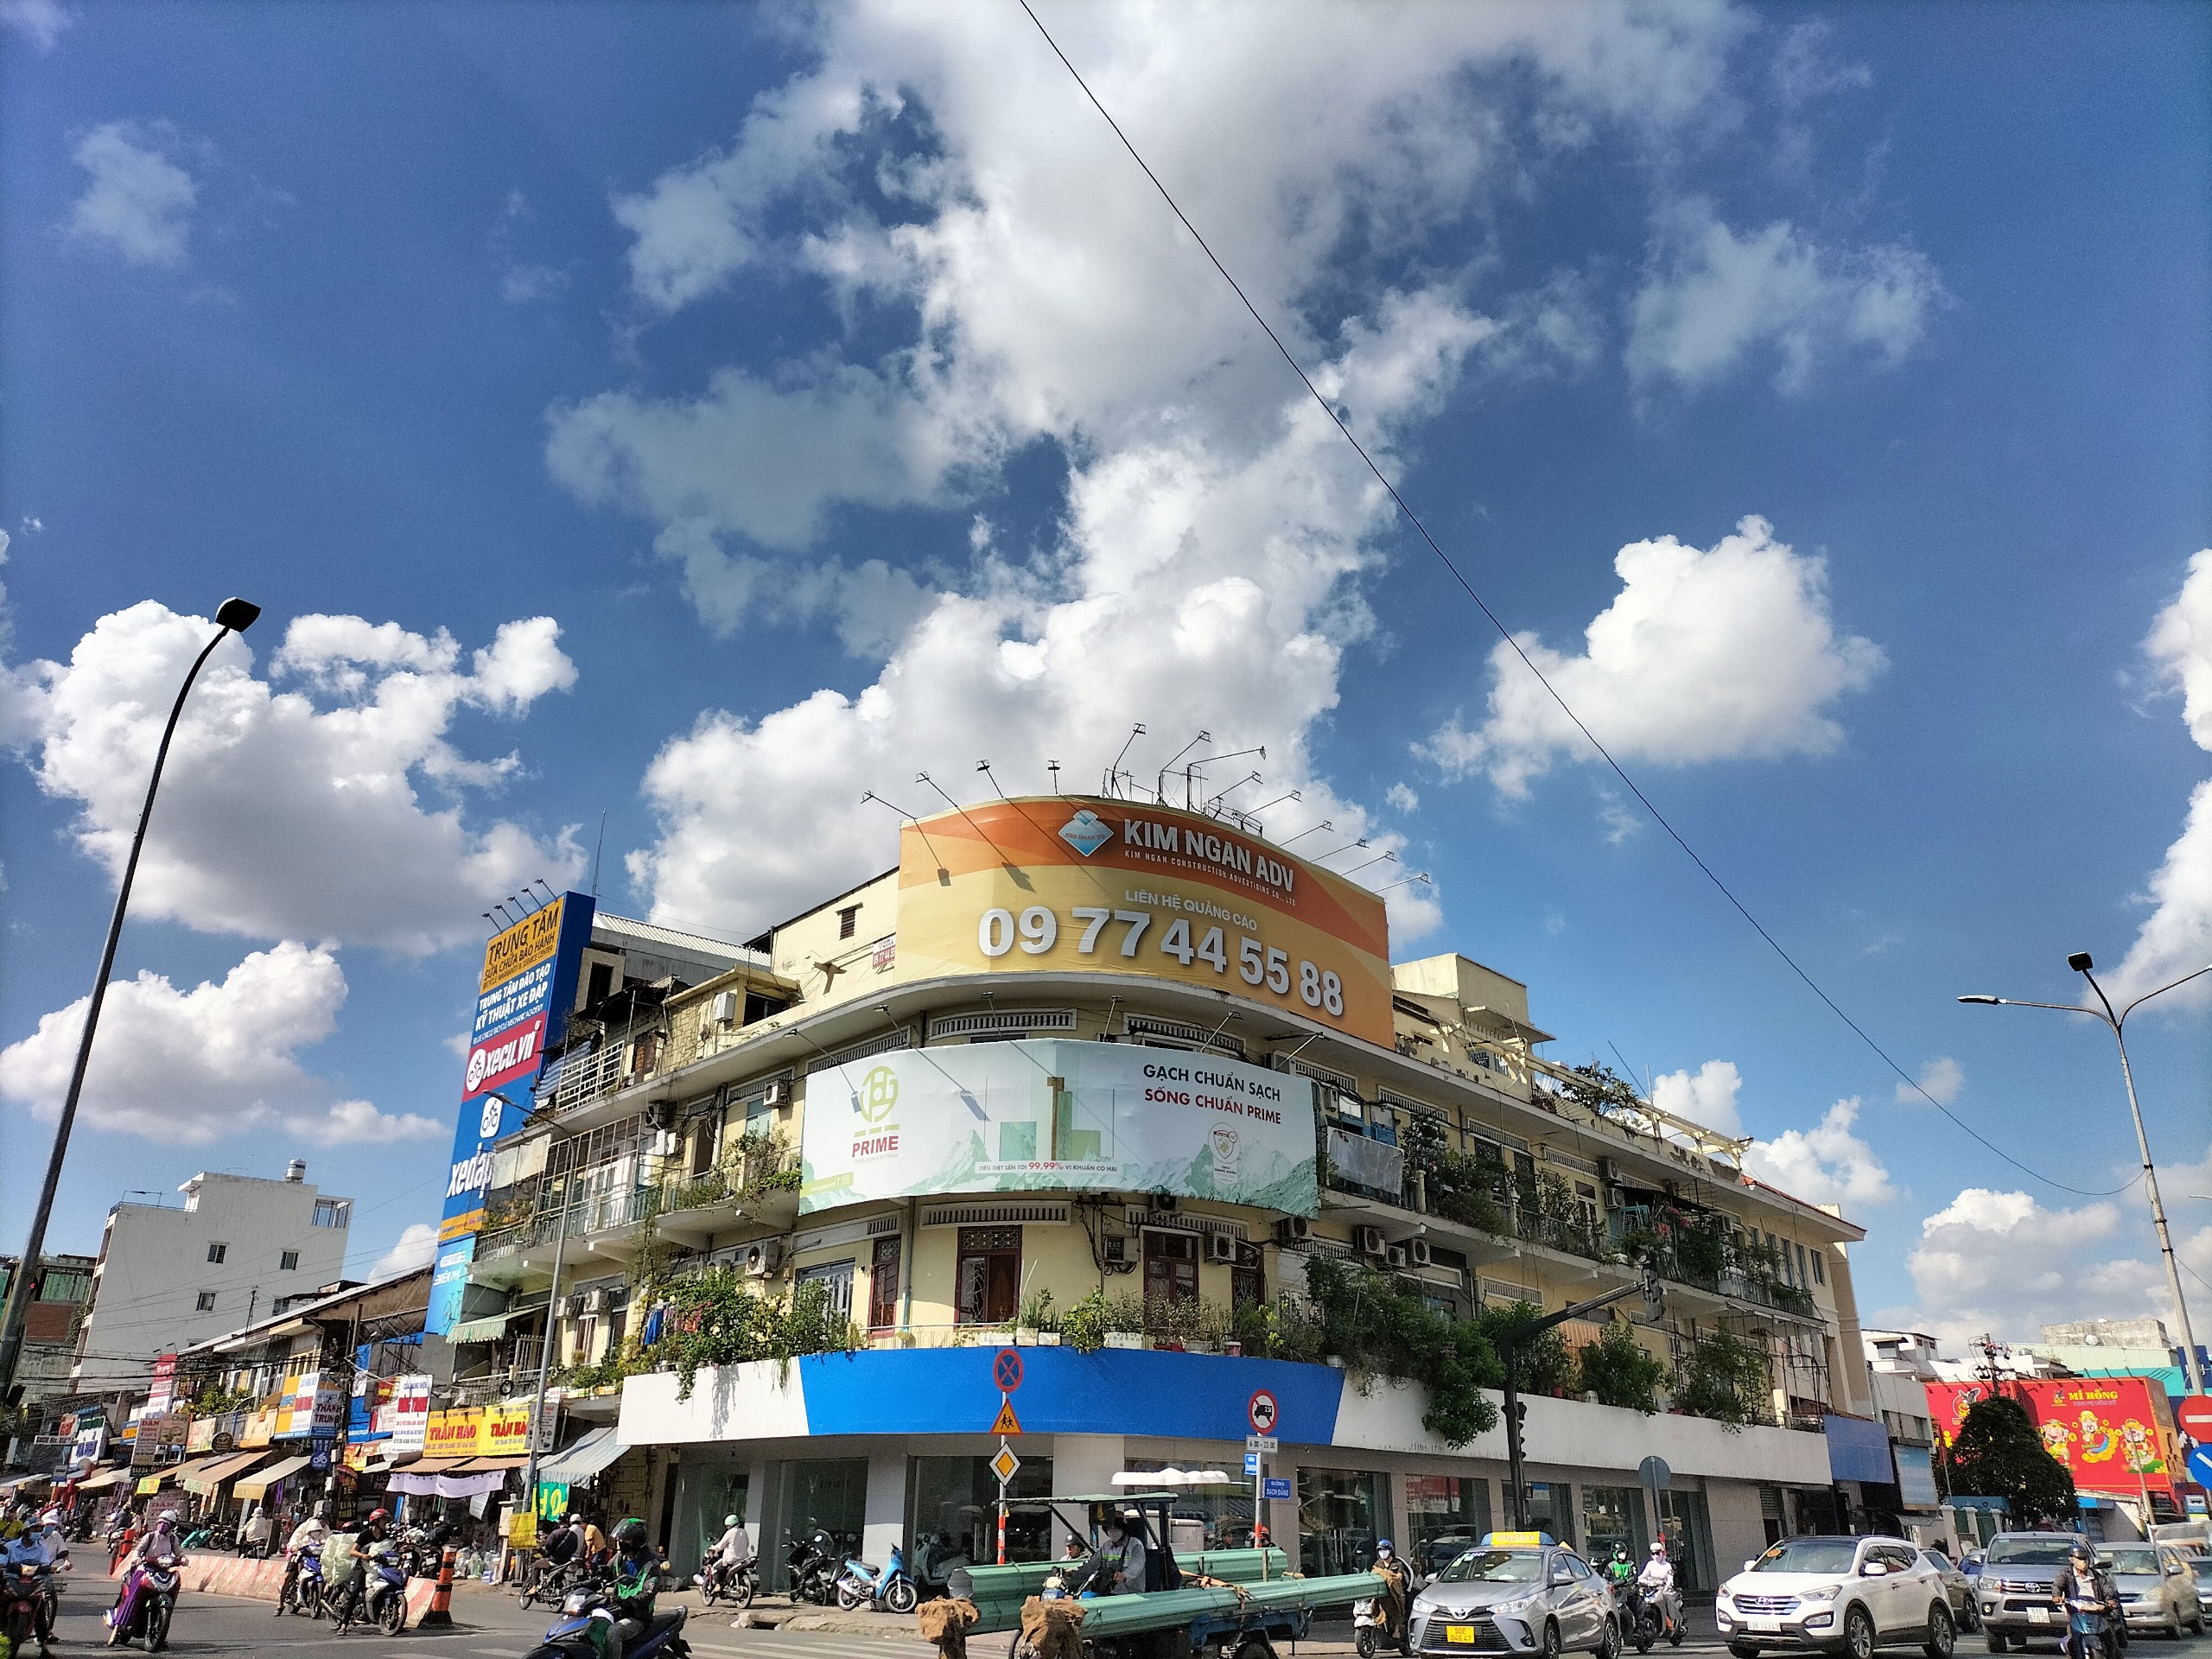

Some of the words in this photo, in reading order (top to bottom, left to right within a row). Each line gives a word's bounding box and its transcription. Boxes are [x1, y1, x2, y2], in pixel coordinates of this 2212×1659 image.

[1124, 818, 1178, 853] KIM
[1185, 830, 1251, 874] NGAN
[1256, 855, 1294, 893] ADV
[1124, 850, 1141, 860] KIM
[1145, 853, 1167, 863] NGAN
[1171, 857, 1227, 879] CONSTRUCTION
[1229, 873, 1269, 896] ADVERTISING
[1125, 889, 1159, 906] LIÊN
[1161, 893, 1181, 911] HỆ
[1183, 899, 1230, 922] QUẢNG
[1232, 911, 1257, 932] CÁO
[489, 925, 529, 965] TRUNG
[532, 906, 560, 939] TÂM
[977, 906, 1058, 957] 09
[1071, 906, 1151, 957] 77
[1160, 918, 1228, 975] 44
[1238, 935, 1290, 995] 55
[1299, 960, 1344, 1017] 88
[475, 1009, 488, 1032] KỸ
[488, 996, 516, 1026] THUẬT
[516, 990, 528, 1011] XE
[528, 981, 549, 1004] ĐẠP
[480, 987, 502, 1011] TRUNG
[503, 981, 518, 999] TÂM
[518, 971, 535, 991] ĐÀO
[535, 963, 550, 983] TẠO
[1143, 1064, 1189, 1082] GẠCH
[1194, 1071, 1244, 1092] CHUẨN
[1249, 1082, 1281, 1102] SẠCH
[1145, 1086, 1190, 1106] SỐNG
[1195, 1096, 1243, 1116] CHUẨN
[1247, 1105, 1281, 1125] PRIME
[852, 1135, 899, 1158] PRIME
[1028, 1161, 1065, 1171] 99,99%
[2085, 1387, 2119, 1400] HỒNG
